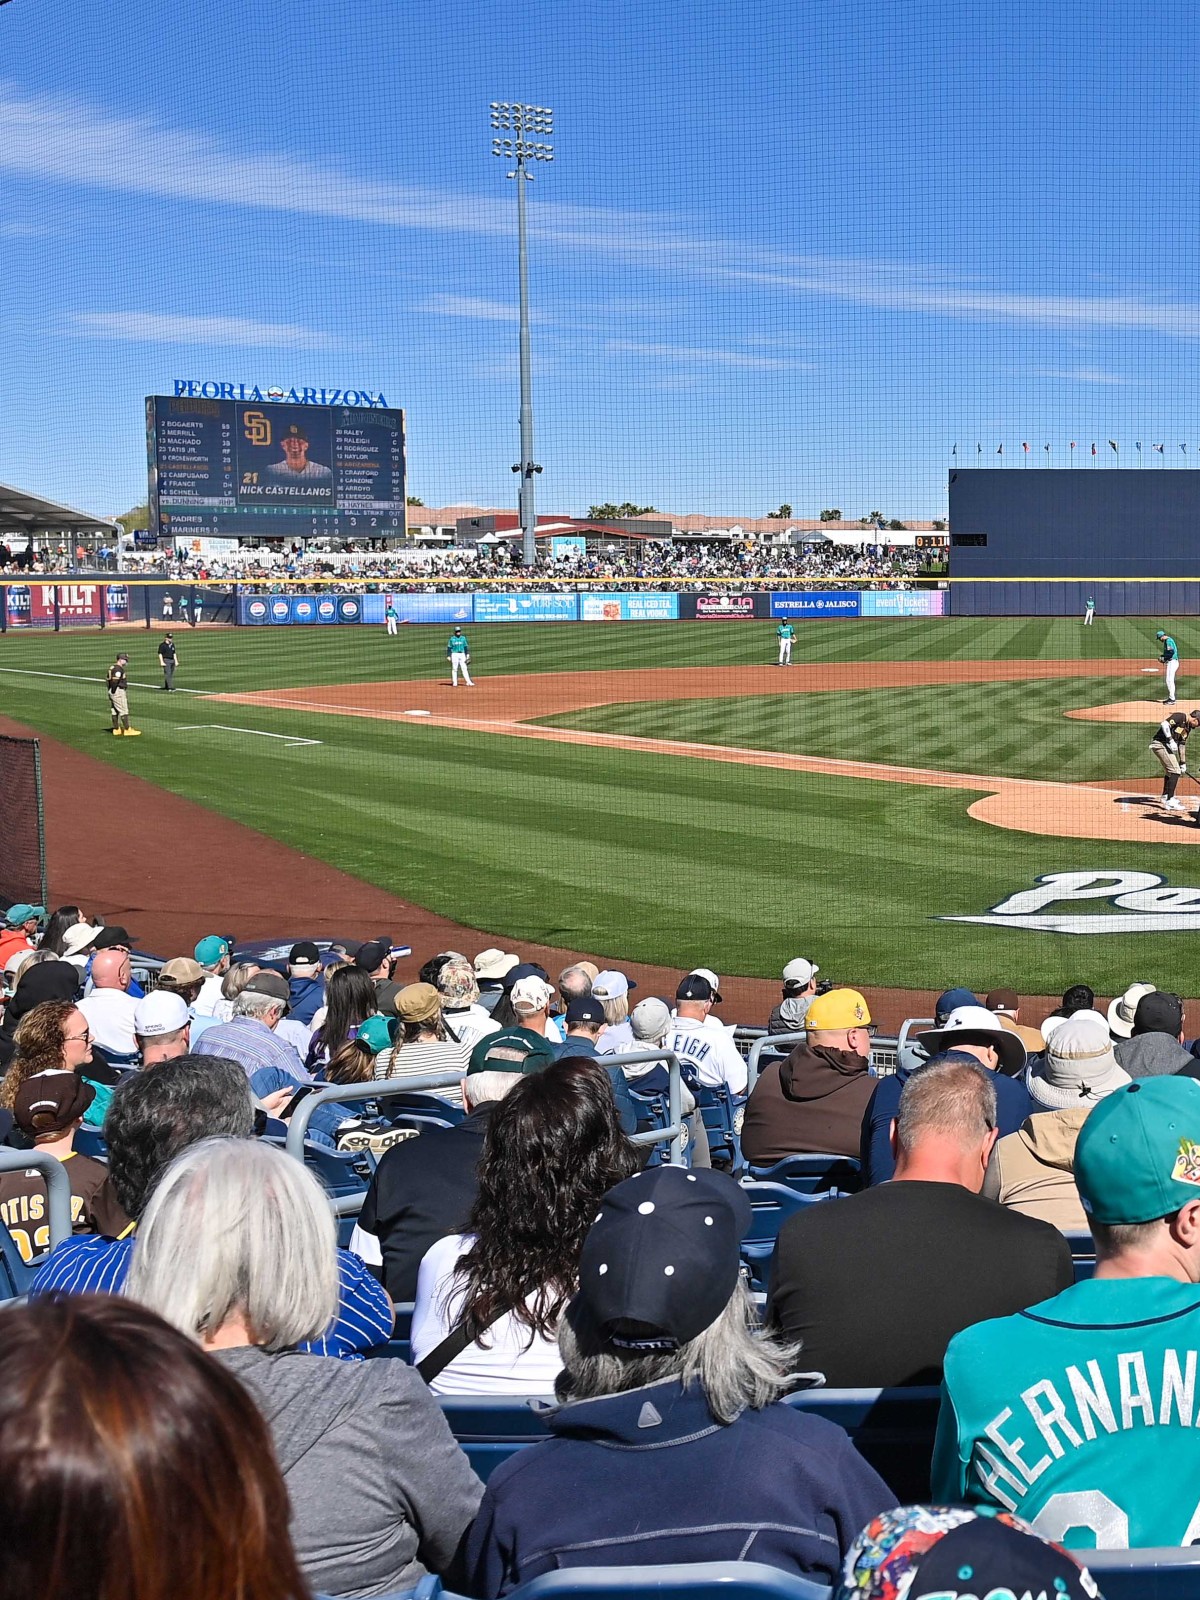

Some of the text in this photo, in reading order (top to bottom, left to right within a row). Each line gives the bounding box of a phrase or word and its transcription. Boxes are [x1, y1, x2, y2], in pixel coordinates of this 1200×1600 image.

[174, 379, 389, 409] PEORIA ARIZONA
[243, 411, 272, 446] SD
[169, 472, 209, 480] CAMPUSANO
[243, 472, 259, 484] 21
[240, 486, 332, 496] NICK CASTELLANOS
[350, 518, 398, 527] 3 2 0
[7, 594, 31, 606] KILT
[41, 585, 97, 607] KILT
[106, 593, 128, 605] KILT
[628, 600, 643, 609] REAL
[644, 600, 658, 609] ICED
[774, 600, 857, 609] ESTRELLA JALISCO
[876, 597, 929, 608] event tickets
[631, 609, 646, 617] REAL
[673, 1034, 711, 1061] EIGH
